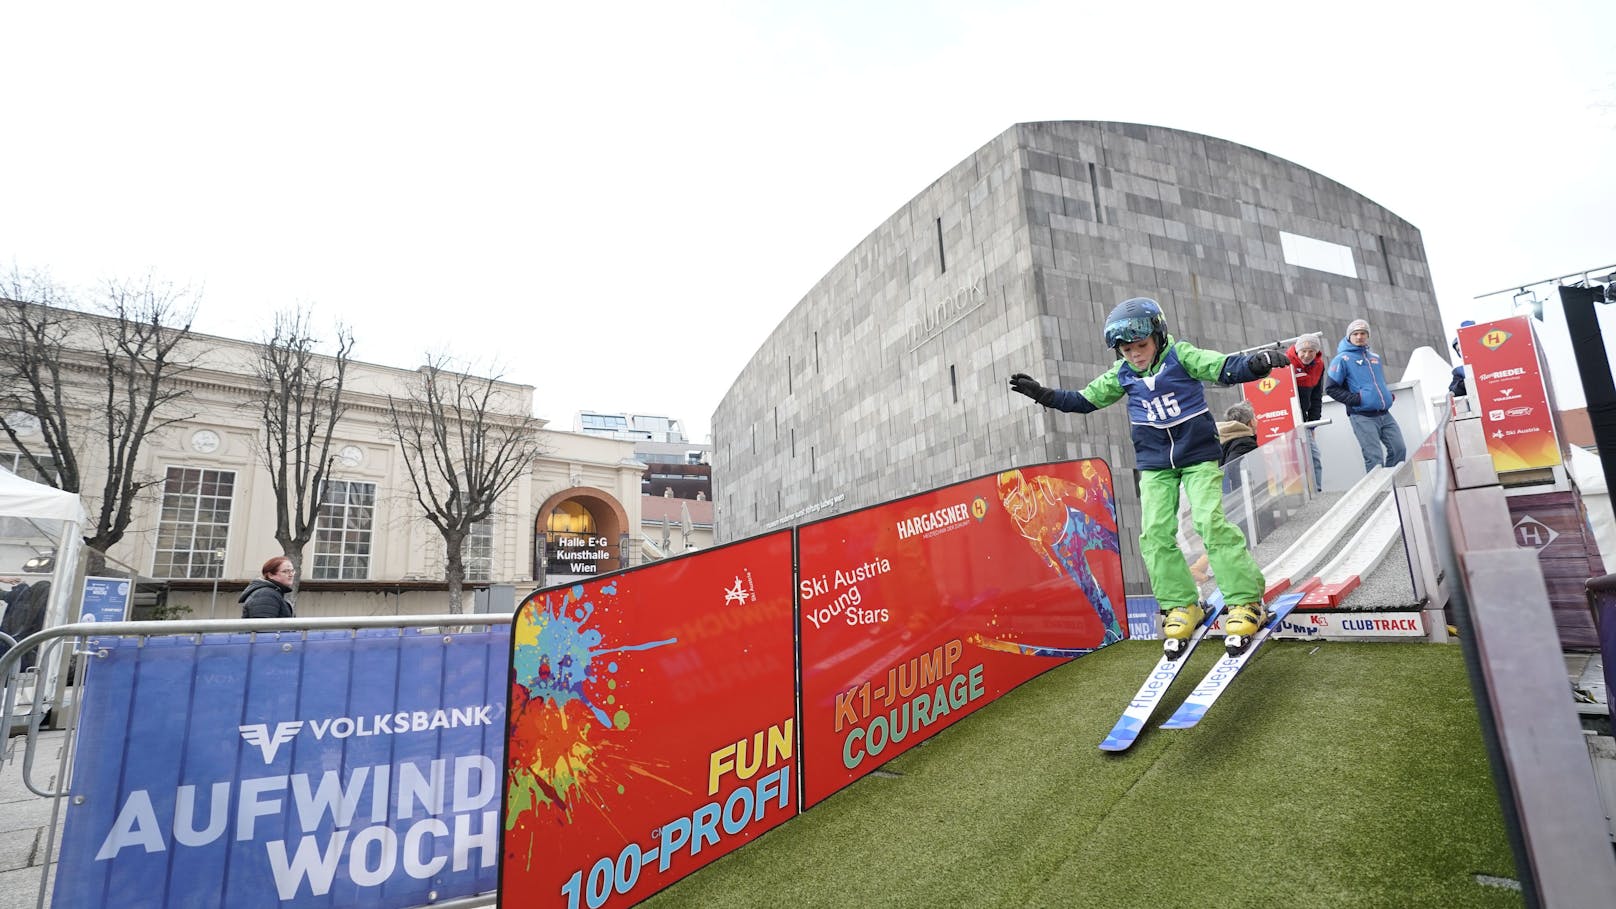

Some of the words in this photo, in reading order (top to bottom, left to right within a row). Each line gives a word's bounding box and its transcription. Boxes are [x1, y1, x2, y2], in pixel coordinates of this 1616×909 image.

[905, 269, 985, 345] mumok
[559, 537, 585, 547] Halle
[896, 503, 969, 540] HARGASSNER
[556, 550, 610, 560] Kunsthalle
[570, 563, 597, 573] Wien
[800, 574, 829, 600] Ski
[834, 557, 891, 589] Austria
[806, 586, 862, 630] Young
[846, 607, 889, 626] Stars
[1342, 619, 1418, 631] CLUBTRACK
[834, 639, 963, 733] K1-JUMP
[309, 704, 492, 740] VOLKSBANK
[843, 663, 985, 769] COURAGE
[708, 717, 794, 796] FUN
[95, 754, 496, 861] AUFWIND
[561, 765, 790, 909] 100-PROFI
